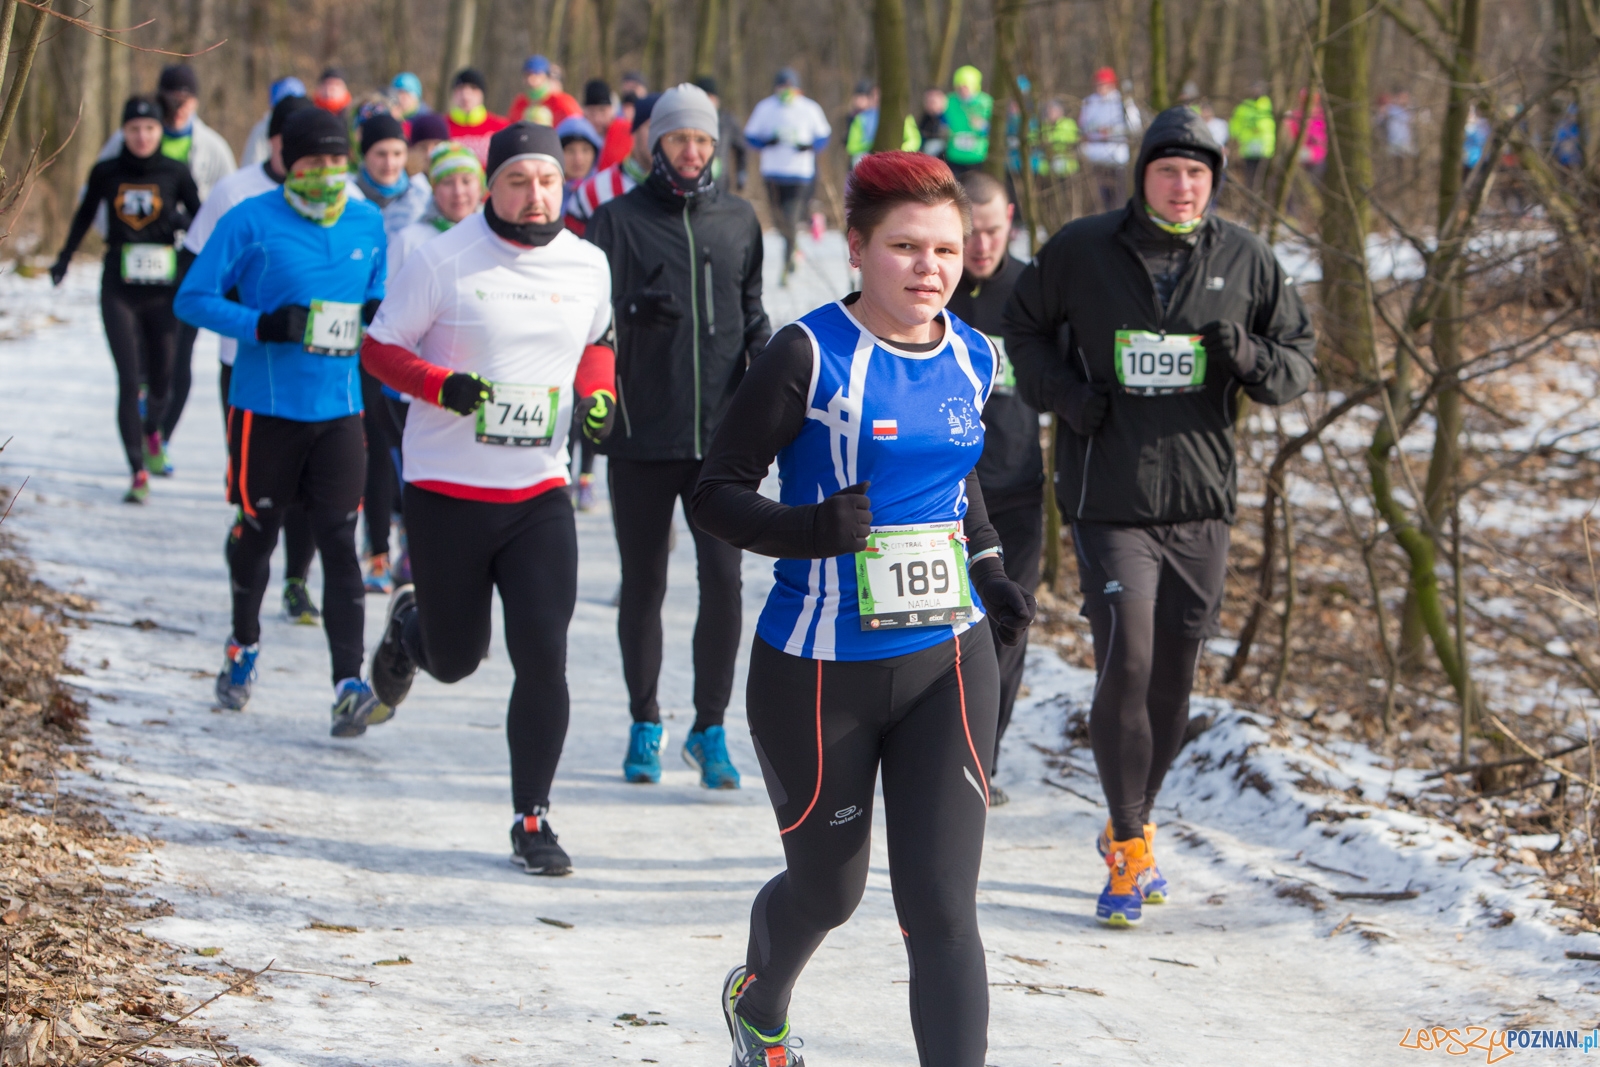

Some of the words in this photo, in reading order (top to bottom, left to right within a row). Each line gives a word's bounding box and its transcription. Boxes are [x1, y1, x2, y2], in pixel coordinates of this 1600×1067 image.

[1127, 351, 1194, 376] 1096
[496, 402, 544, 426] 744
[889, 559, 950, 597] 189
[907, 598, 942, 609] NATALIA
